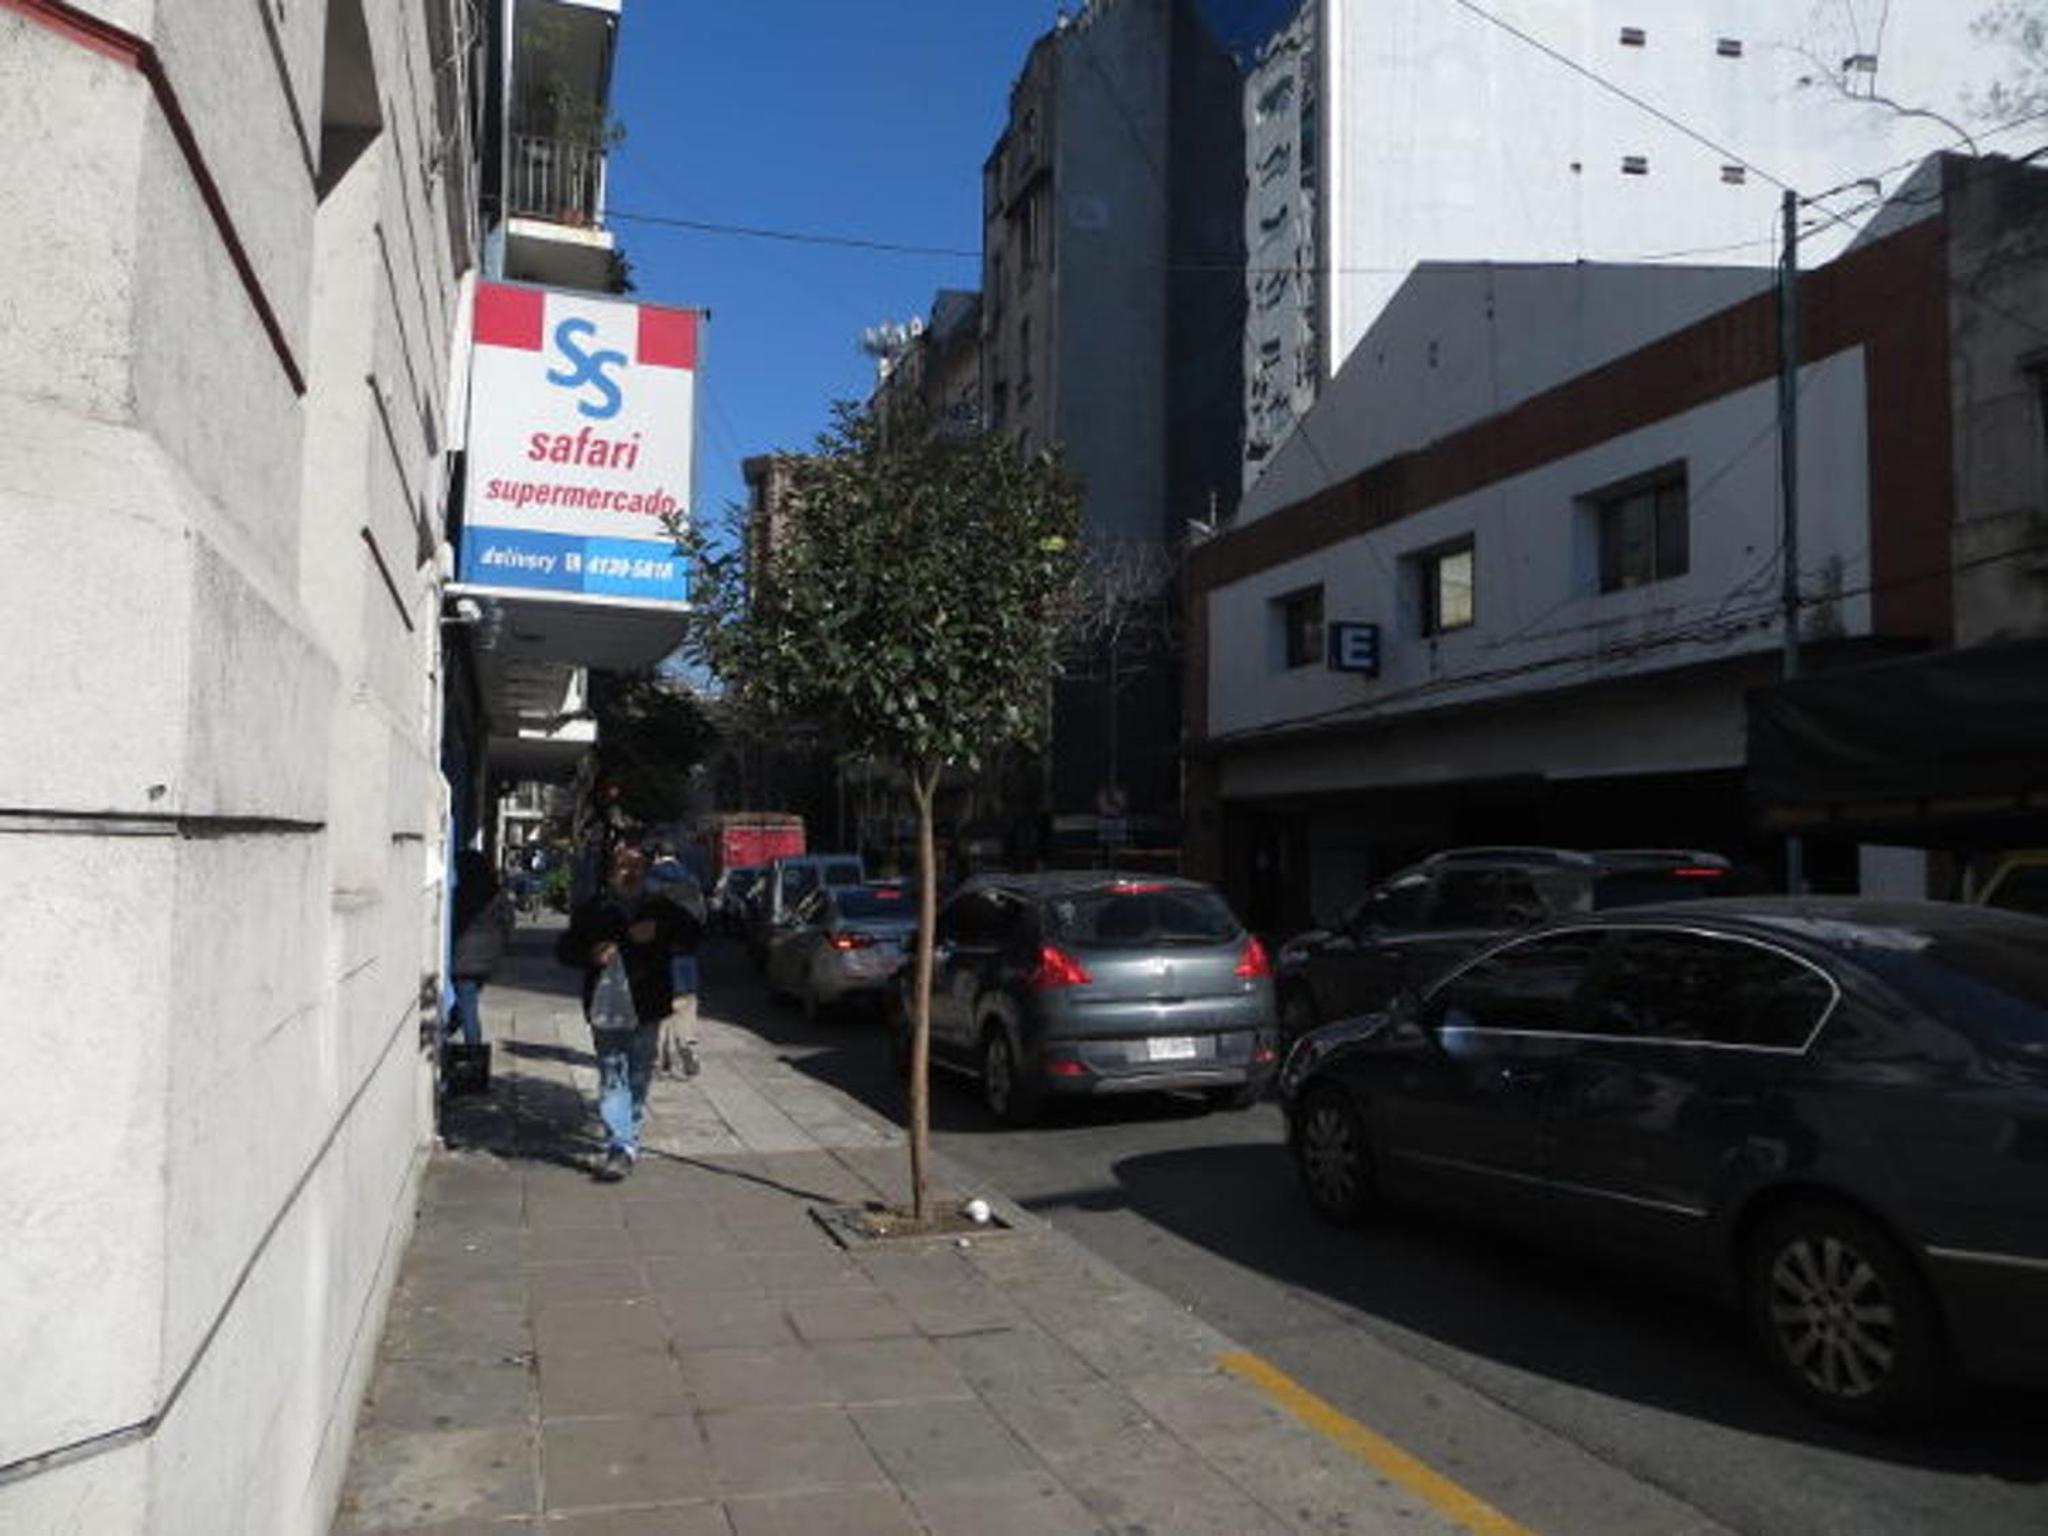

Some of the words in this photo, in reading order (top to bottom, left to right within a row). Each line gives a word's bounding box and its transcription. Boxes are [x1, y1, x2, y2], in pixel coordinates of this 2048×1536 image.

[528, 426, 641, 470] safari
[486, 478, 677, 516] supermercado
[480, 546, 557, 574] delivery
[1341, 628, 1373, 667] E
